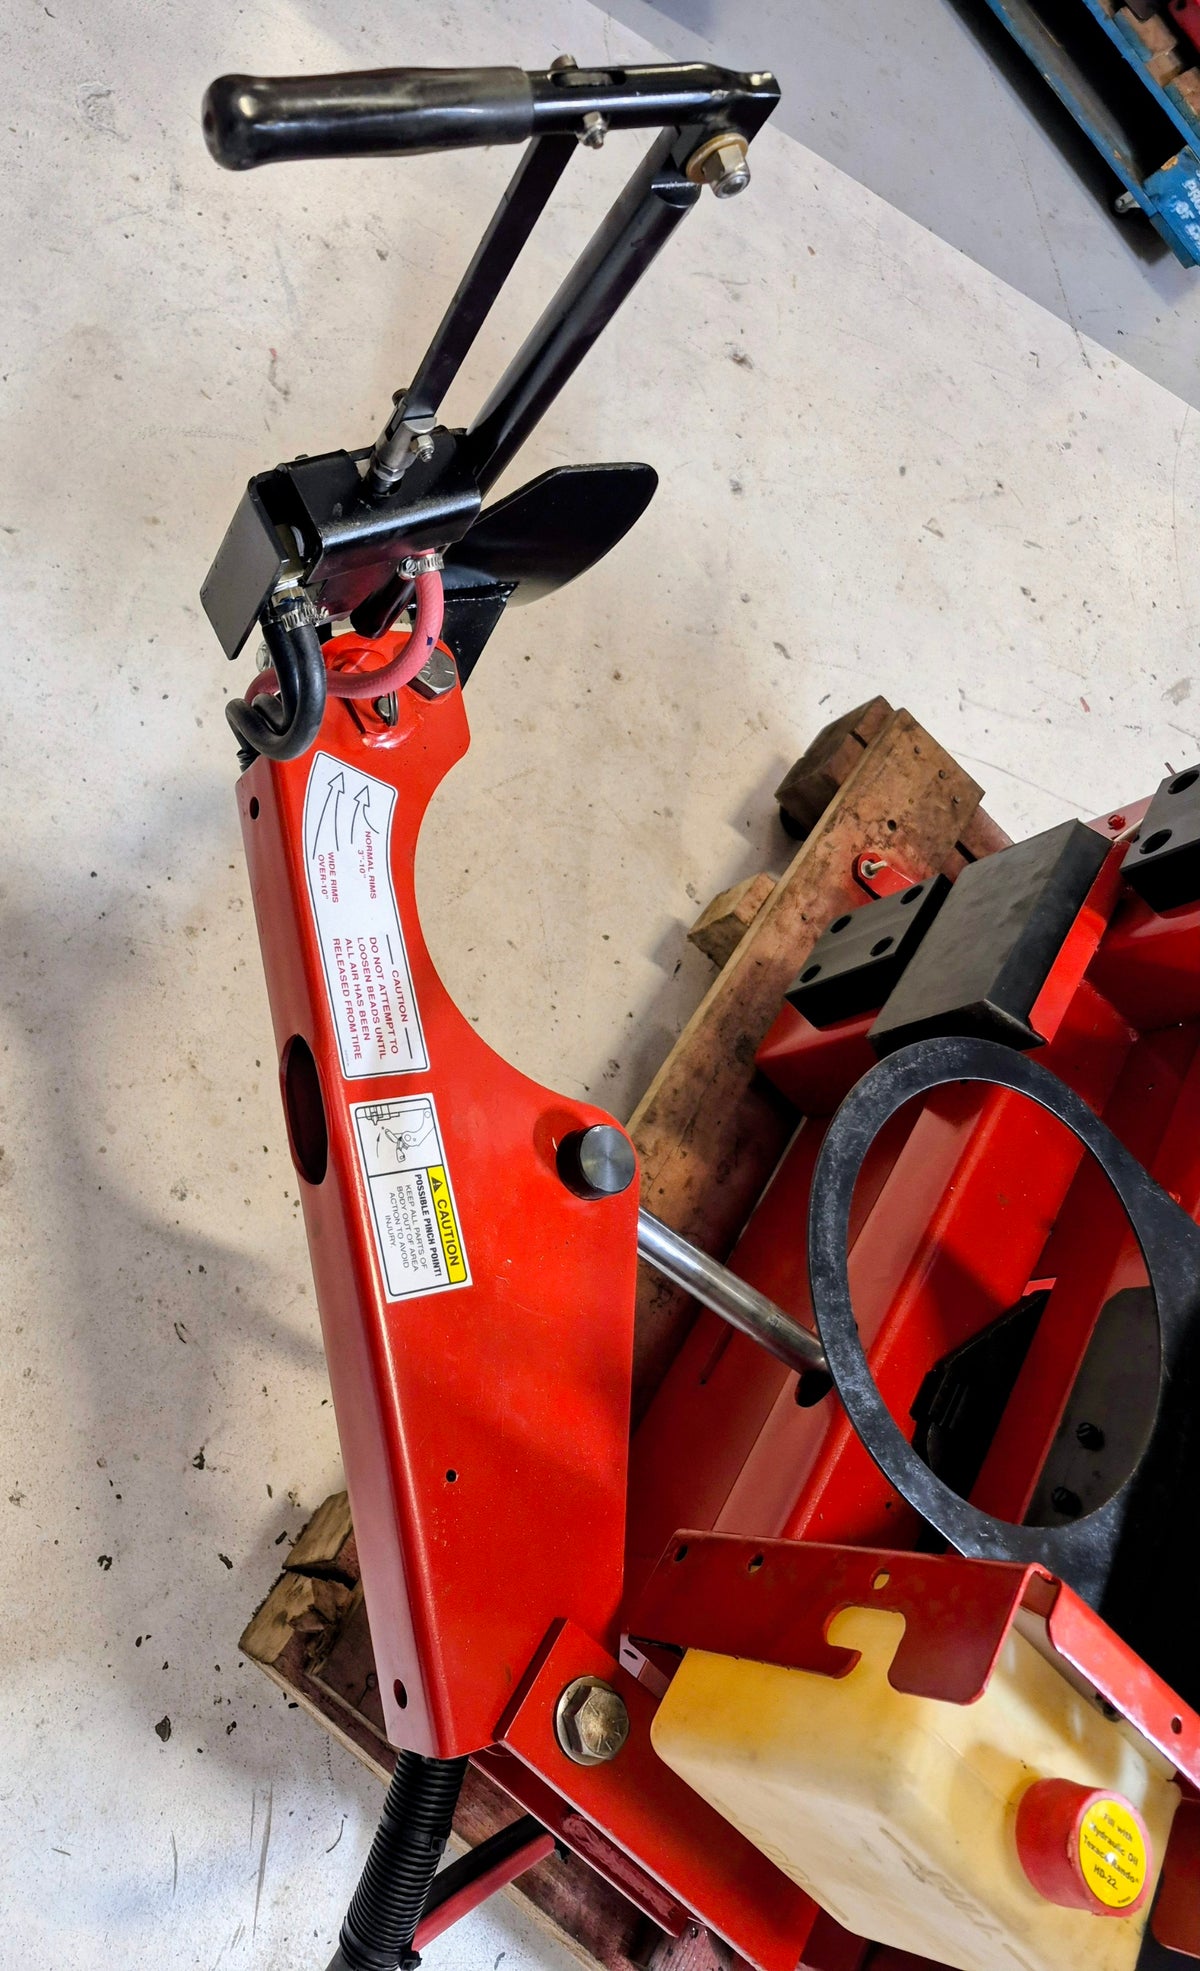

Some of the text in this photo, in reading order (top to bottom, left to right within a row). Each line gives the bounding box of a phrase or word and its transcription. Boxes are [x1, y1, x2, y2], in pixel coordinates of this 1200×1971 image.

[328, 852, 339, 903] WIDE RIMS
[365, 831, 374, 872] NORMAL
[332, 938, 362, 1060] RELEASED FROM TIRE
[345, 938, 371, 1041] ALL AIR HAS BEEN
[357, 937, 386, 1059] LOOSEN BEADS UNTIL
[369, 937, 399, 1054] DO NOT ATTEMPT TO
[392, 970, 408, 1022] CAUTION
[389, 1192, 410, 1269] ACTION TO AVOID
[397, 1186, 419, 1272] BODY OUT OF AREA
[405, 1184, 428, 1269] KEEP ALL PARTS OF
[414, 1174, 442, 1277] POSSIBLE PINCH POINT!
[437, 1199, 460, 1266] CAUTION
[1117, 1825, 1133, 1842] with
[1127, 1852, 1139, 1867] Oil
